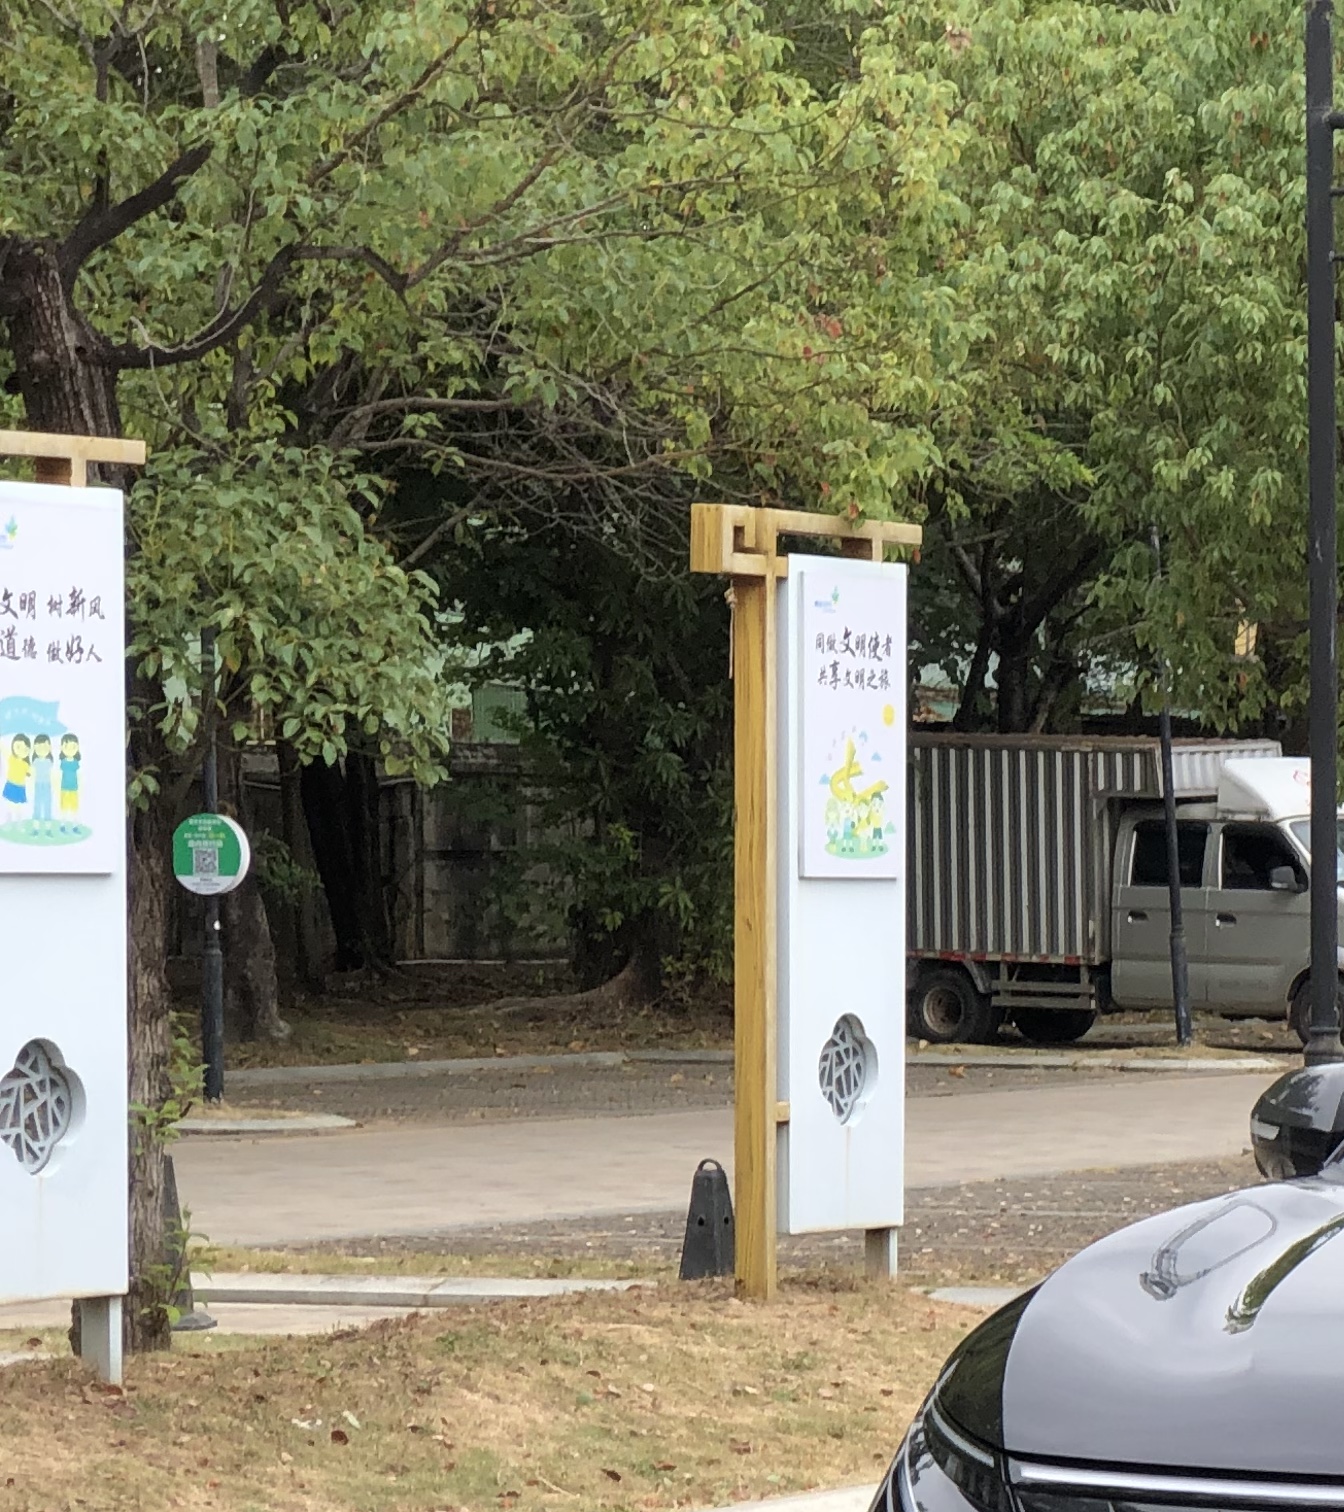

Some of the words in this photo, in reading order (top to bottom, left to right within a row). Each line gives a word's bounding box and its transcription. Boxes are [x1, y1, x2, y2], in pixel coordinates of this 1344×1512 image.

[47, 586, 105, 622] 树新风
[47, 634, 103, 664] 做好人
